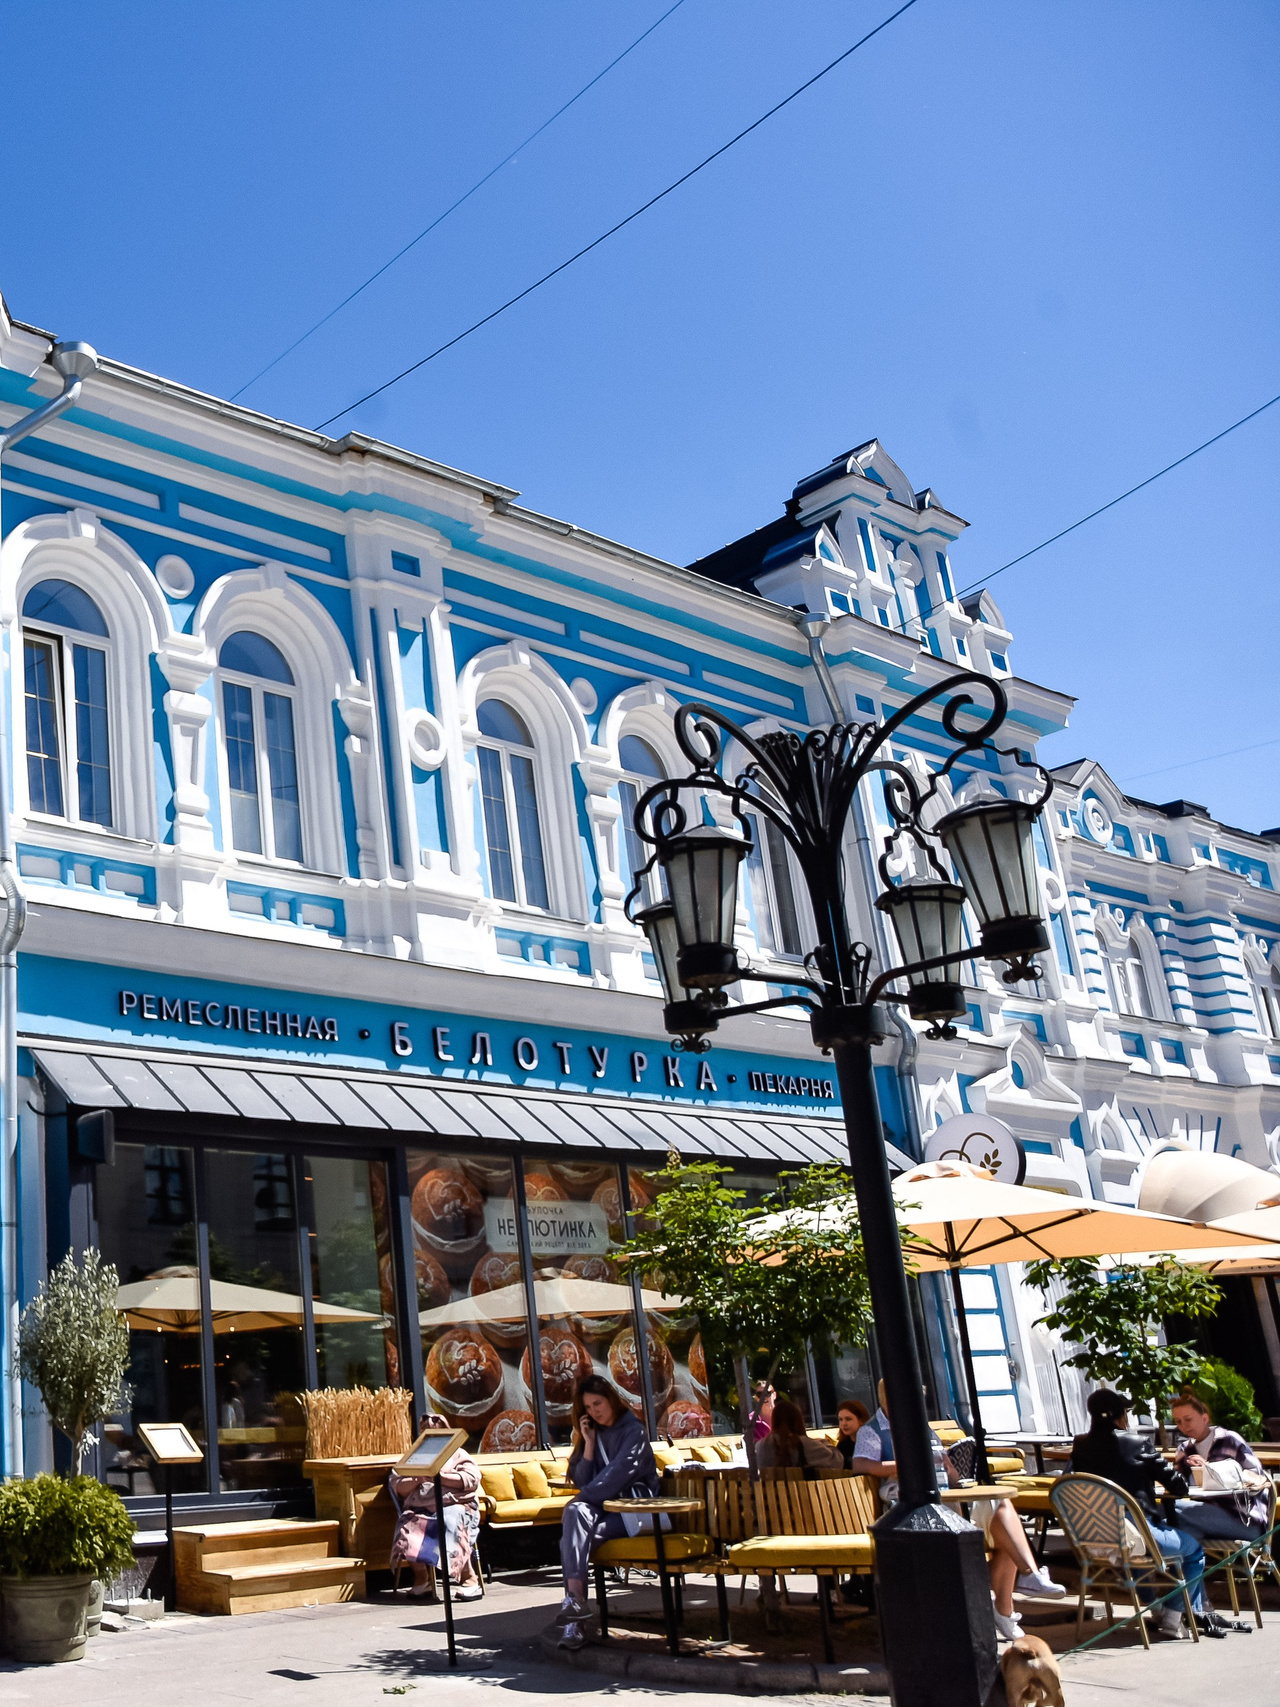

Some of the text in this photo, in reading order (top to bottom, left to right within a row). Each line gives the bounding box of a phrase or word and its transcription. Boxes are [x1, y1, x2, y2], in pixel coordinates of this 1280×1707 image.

[120, 990, 835, 1099] РЕМЕСЛЕННАЯ БЕЛОТУРКА ПЕКАРНЯ
[497, 1218, 597, 1238] НЕЛЮТИНКА
